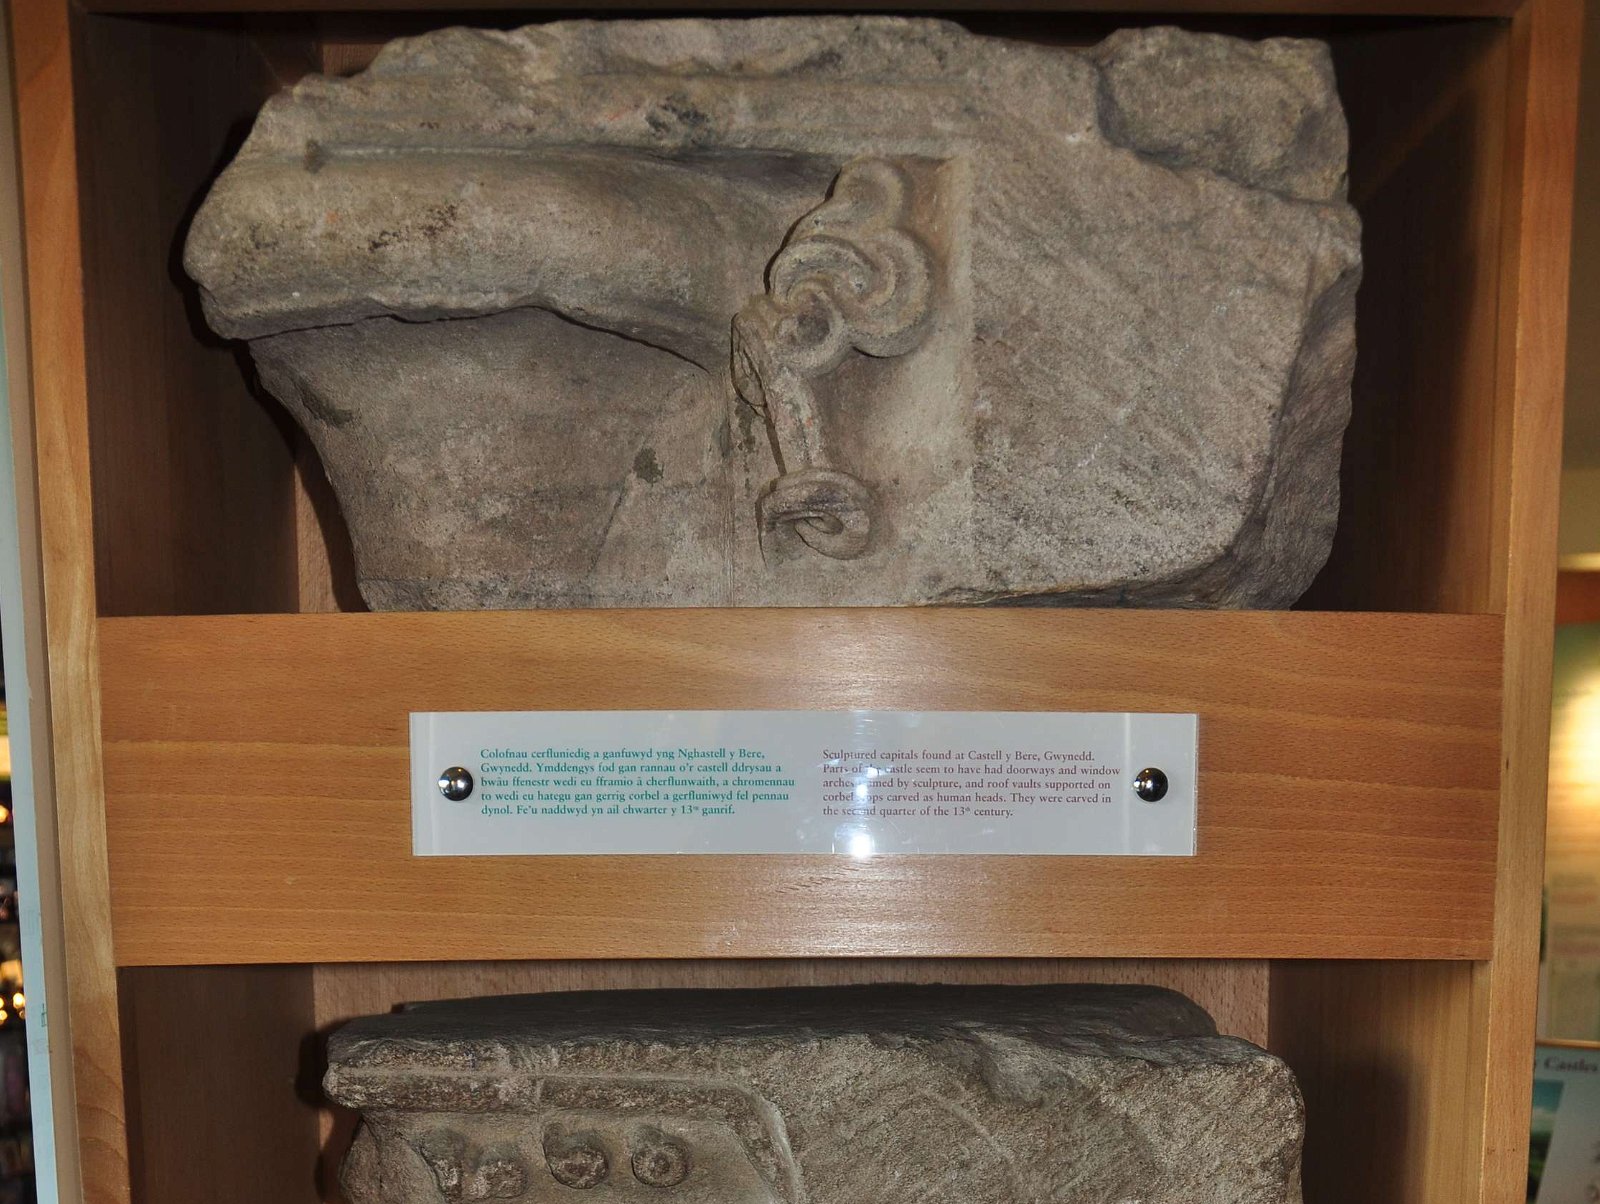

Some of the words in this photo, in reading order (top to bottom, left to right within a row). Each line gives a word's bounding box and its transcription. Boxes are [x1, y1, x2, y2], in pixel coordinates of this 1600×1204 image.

[480, 749, 527, 758] Colofnau
[531, 749, 590, 761] cerfluniedig
[602, 749, 653, 761] ganfuwyd
[656, 751, 675, 761] yng
[678, 748, 726, 761] Nghastell
[739, 748, 765, 761] Bere,
[823, 750, 877, 763] Sculptured
[880, 750, 918, 763] capitals
[922, 750, 952, 760] found
[955, 752, 964, 760] at
[968, 750, 1002, 760] Castell
[1015, 750, 1040, 764] Bere,
[1044, 751, 1095, 764] Gwynedd.
[480, 763, 532, 775] Gwynedd.
[536, 763, 594, 775] Ymddengys
[598, 763, 615, 772] fod
[618, 765, 637, 775] gan
[697, 763, 728, 772] castell
[732, 763, 772, 775] ddrysau
[852, 764, 863, 774] of
[944, 765, 954, 774] to
[957, 764, 981, 774] have
[984, 764, 1003, 774] had
[1006, 764, 1055, 778] doorways
[1058, 765, 1077, 775] and
[1080, 765, 1120, 775] window
[512, 777, 550, 786] ffenestr
[553, 777, 577, 786] wedi
[596, 777, 633, 786] fframio
[646, 777, 720, 789] cherflunwaith,
[732, 777, 795, 786] chromennau
[897, 778, 909, 791] by
[912, 778, 962, 792] sculpture,
[965, 778, 984, 788] and
[987, 778, 1010, 789] roof
[1012, 779, 1041, 789] vaults
[1044, 779, 1095, 792] supported
[481, 791, 492, 800] to
[495, 790, 519, 800] wedi
[537, 790, 571, 803] hategu
[574, 793, 592, 803] gan
[596, 792, 626, 803] gerrig
[629, 790, 660, 800] corbel
[672, 790, 732, 803] gerfluniwyd
[736, 790, 749, 800] fel
[752, 793, 789, 803] pennau
[887, 792, 920, 802] carved
[937, 792, 971, 802] human
[975, 792, 1006, 802] heads.
[1010, 793, 1036, 806] They
[1066, 793, 1098, 803] carved
[1101, 794, 1111, 803] in
[481, 805, 513, 818] dynol.
[541, 805, 587, 818] naddwyd
[591, 808, 603, 817] yn
[607, 805, 619, 814] ail
[623, 805, 667, 814] chwarter
[702, 805, 735, 817] ganrif.
[823, 806, 839, 816] the
[879, 807, 916, 819] quarter
[920, 806, 931, 816] of
[934, 806, 950, 816] the
[974, 808, 1014, 820] century.
